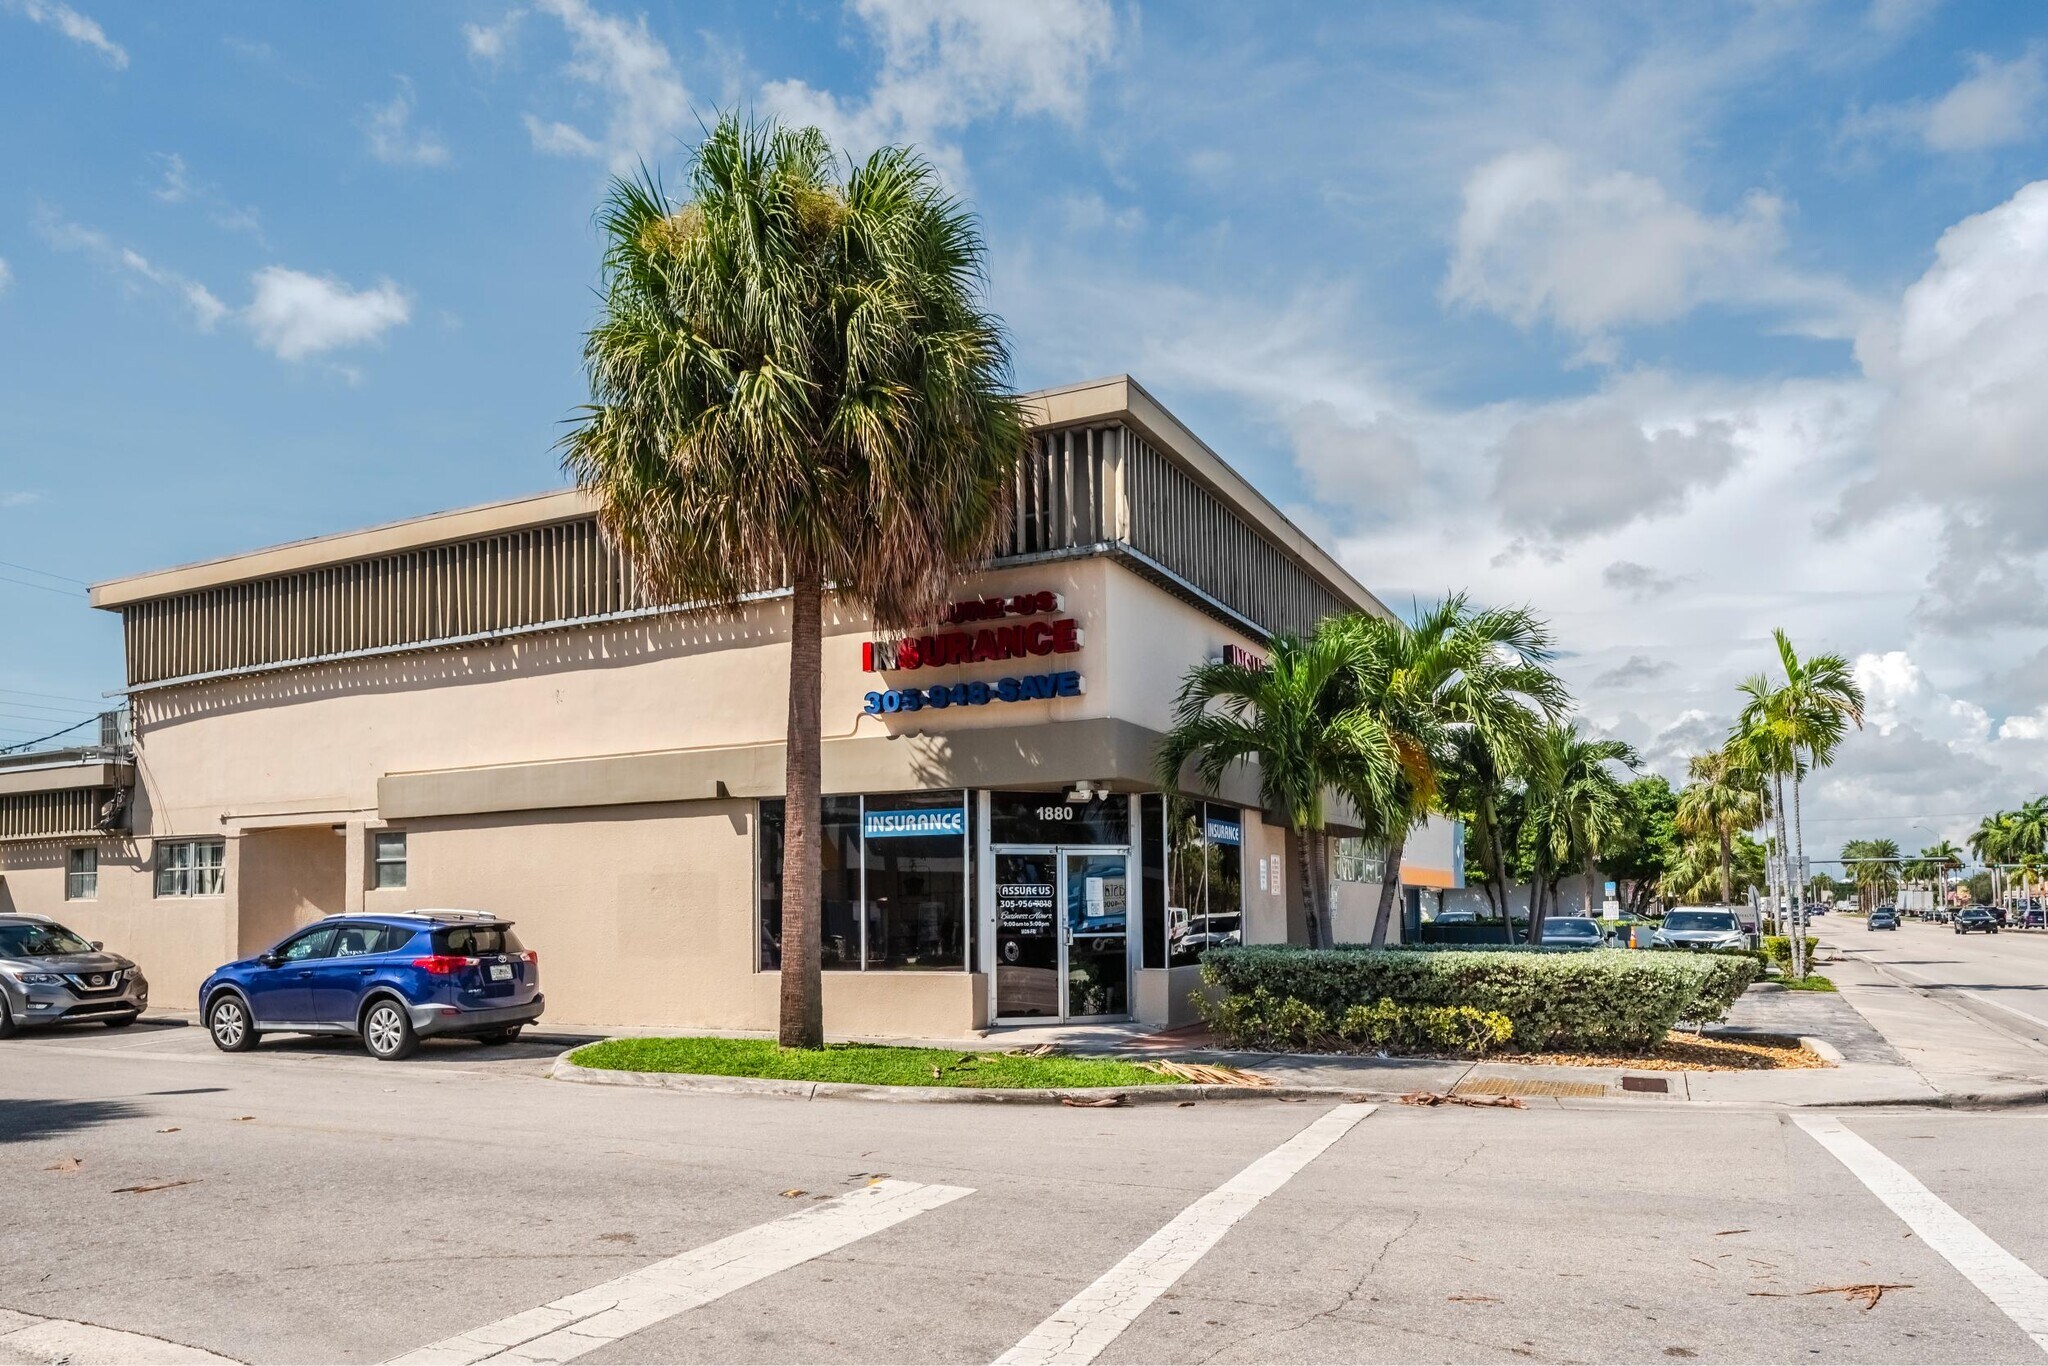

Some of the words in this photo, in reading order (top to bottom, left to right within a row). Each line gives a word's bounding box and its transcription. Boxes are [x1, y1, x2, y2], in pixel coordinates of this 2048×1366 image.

[863, 618, 1081, 673] INSURANCE
[864, 670, 1081, 714] 305-948-SAVE
[867, 812, 961, 833] INSURANCE
[1036, 806, 1073, 820] 1880
[1207, 822, 1239, 841] INSURANCE
[1002, 886, 1037, 895] ASSURE
[1038, 886, 1051, 895] US
